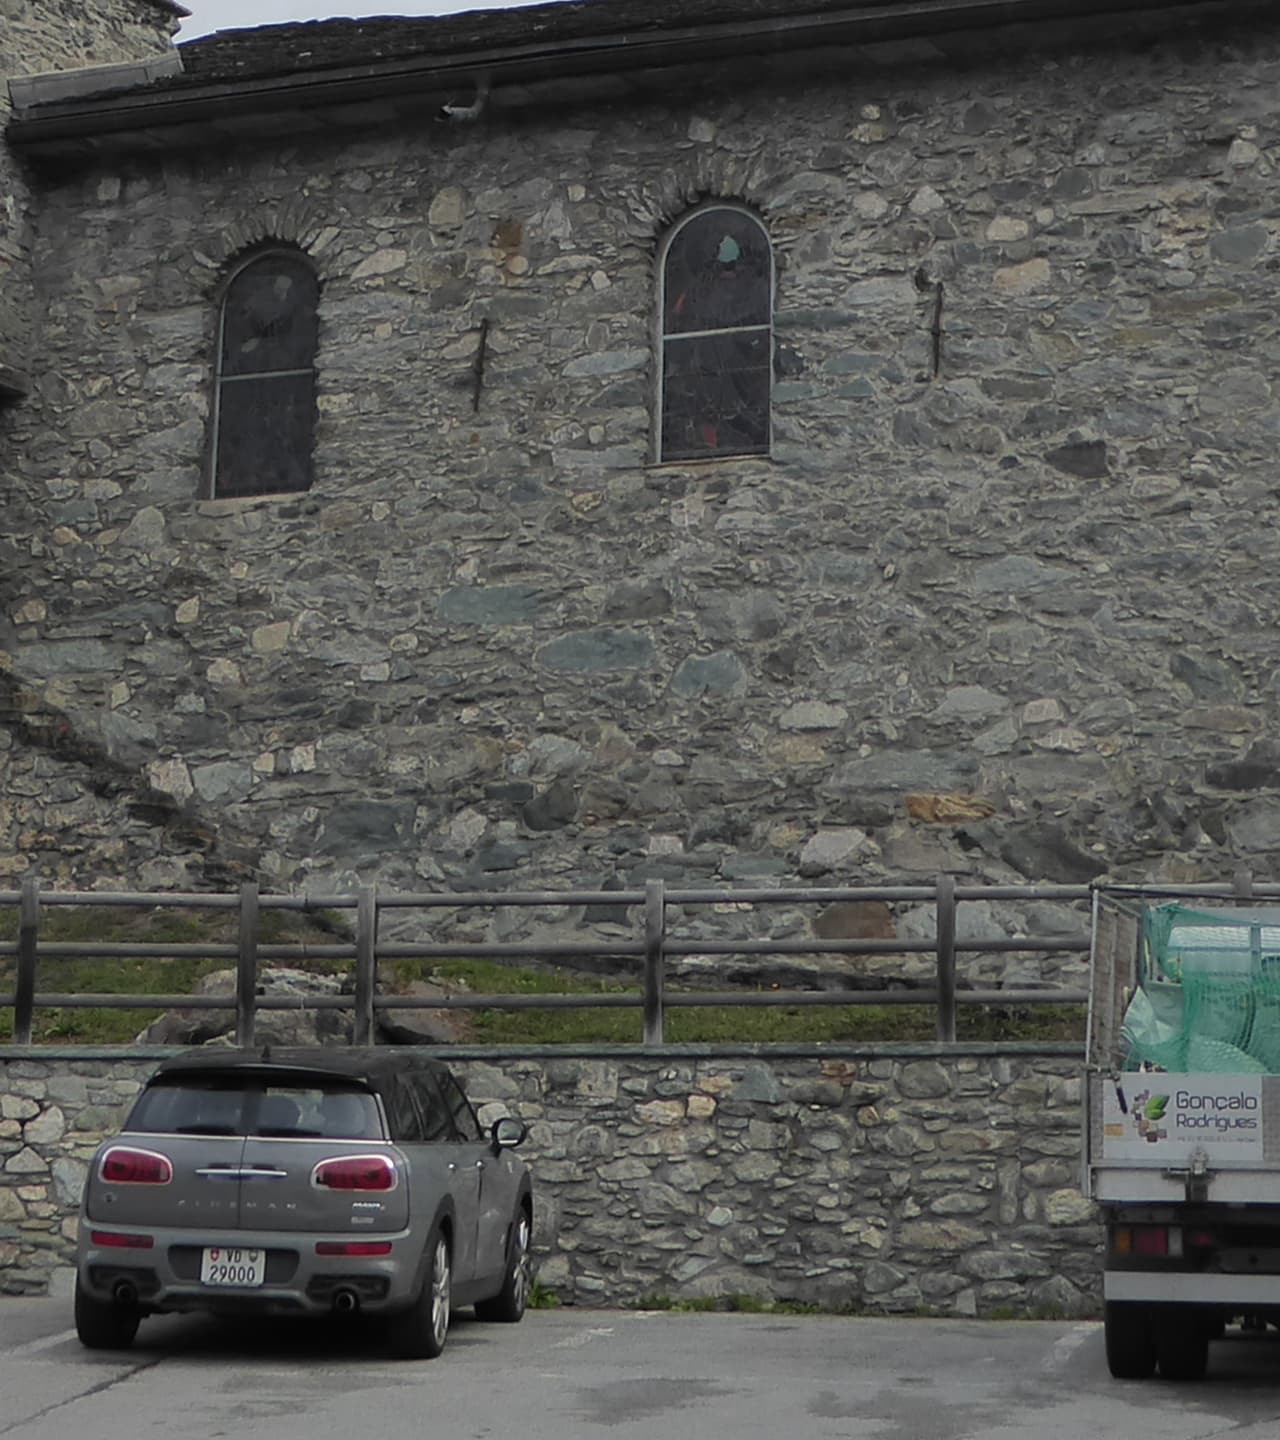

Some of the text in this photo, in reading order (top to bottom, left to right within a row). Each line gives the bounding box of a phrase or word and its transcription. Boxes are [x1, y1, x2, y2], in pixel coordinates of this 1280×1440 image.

[1176, 1090, 1258, 1111] Gonçalo
[1176, 1113, 1258, 1132] Rodrigues
[227, 1249, 242, 1263] VD
[209, 1264, 256, 1282] 29000
